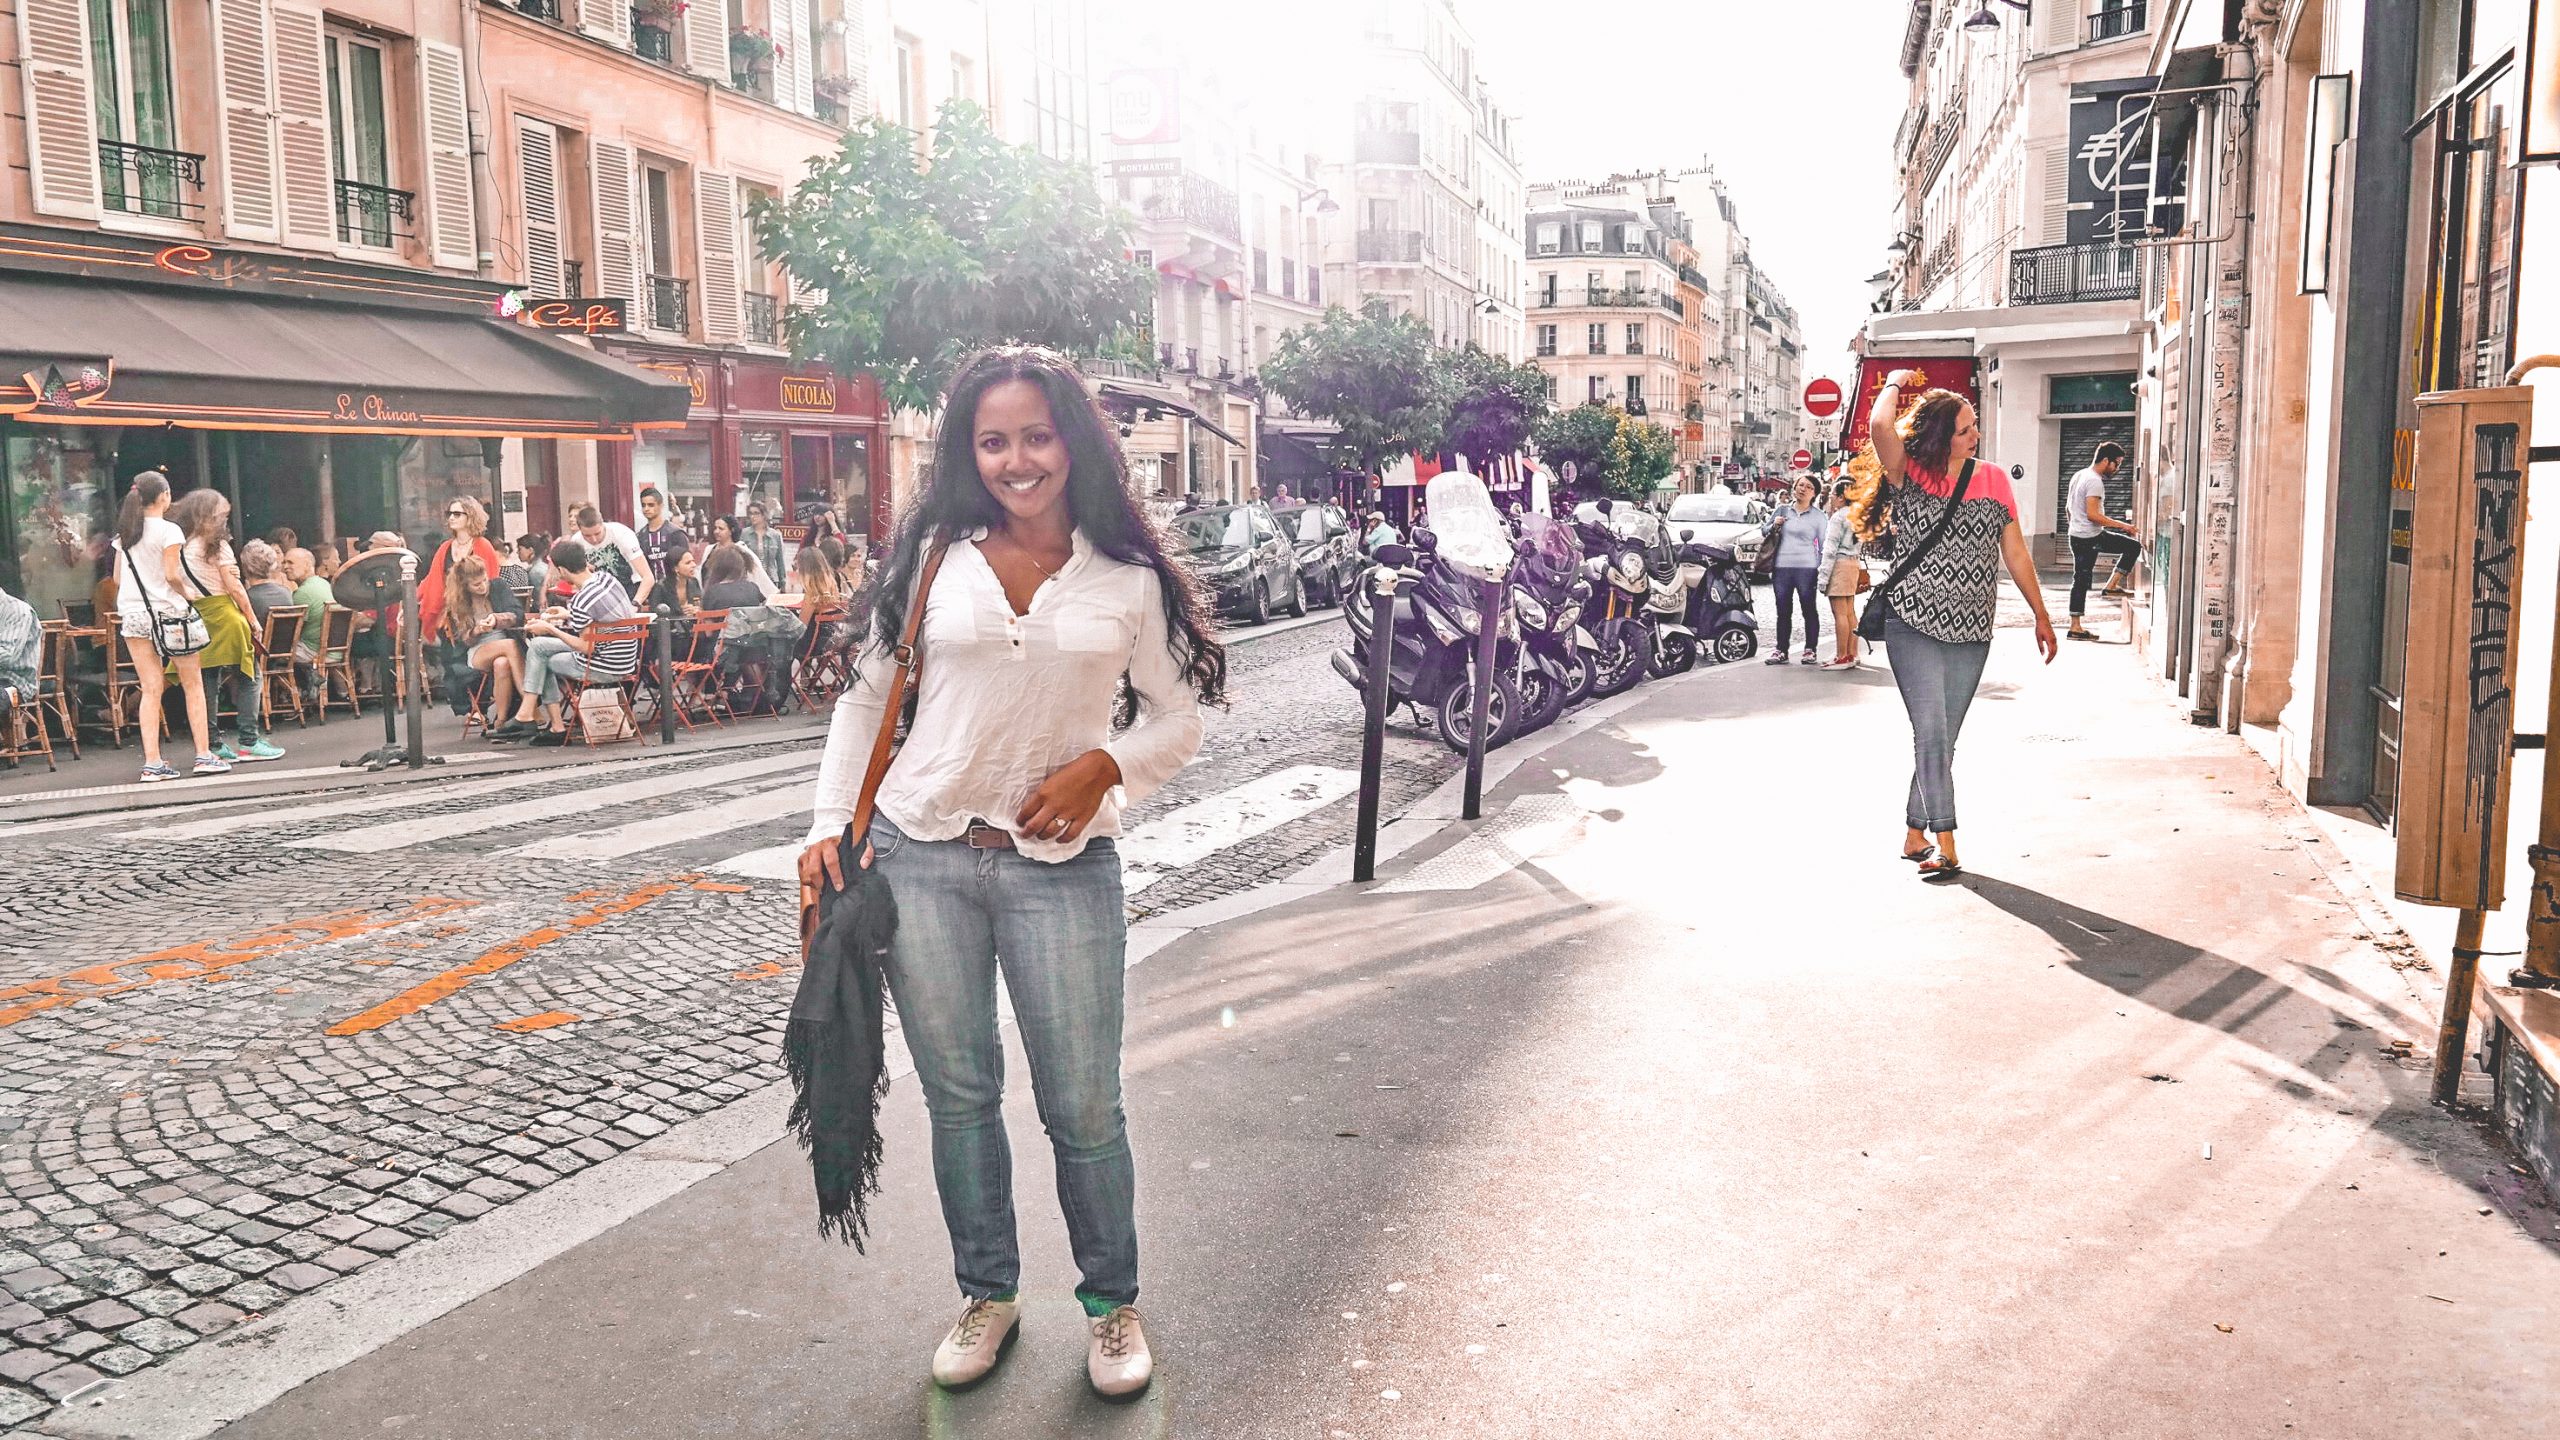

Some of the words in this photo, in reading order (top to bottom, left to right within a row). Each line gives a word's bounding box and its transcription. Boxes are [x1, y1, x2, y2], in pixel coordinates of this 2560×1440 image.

[1118, 162, 1176, 173] MONTMARTRE
[531, 303, 620, 334] Café
[333, 393, 358, 420] Le
[363, 394, 418, 421] Chinon
[783, 383, 833, 406] NICOLAS
